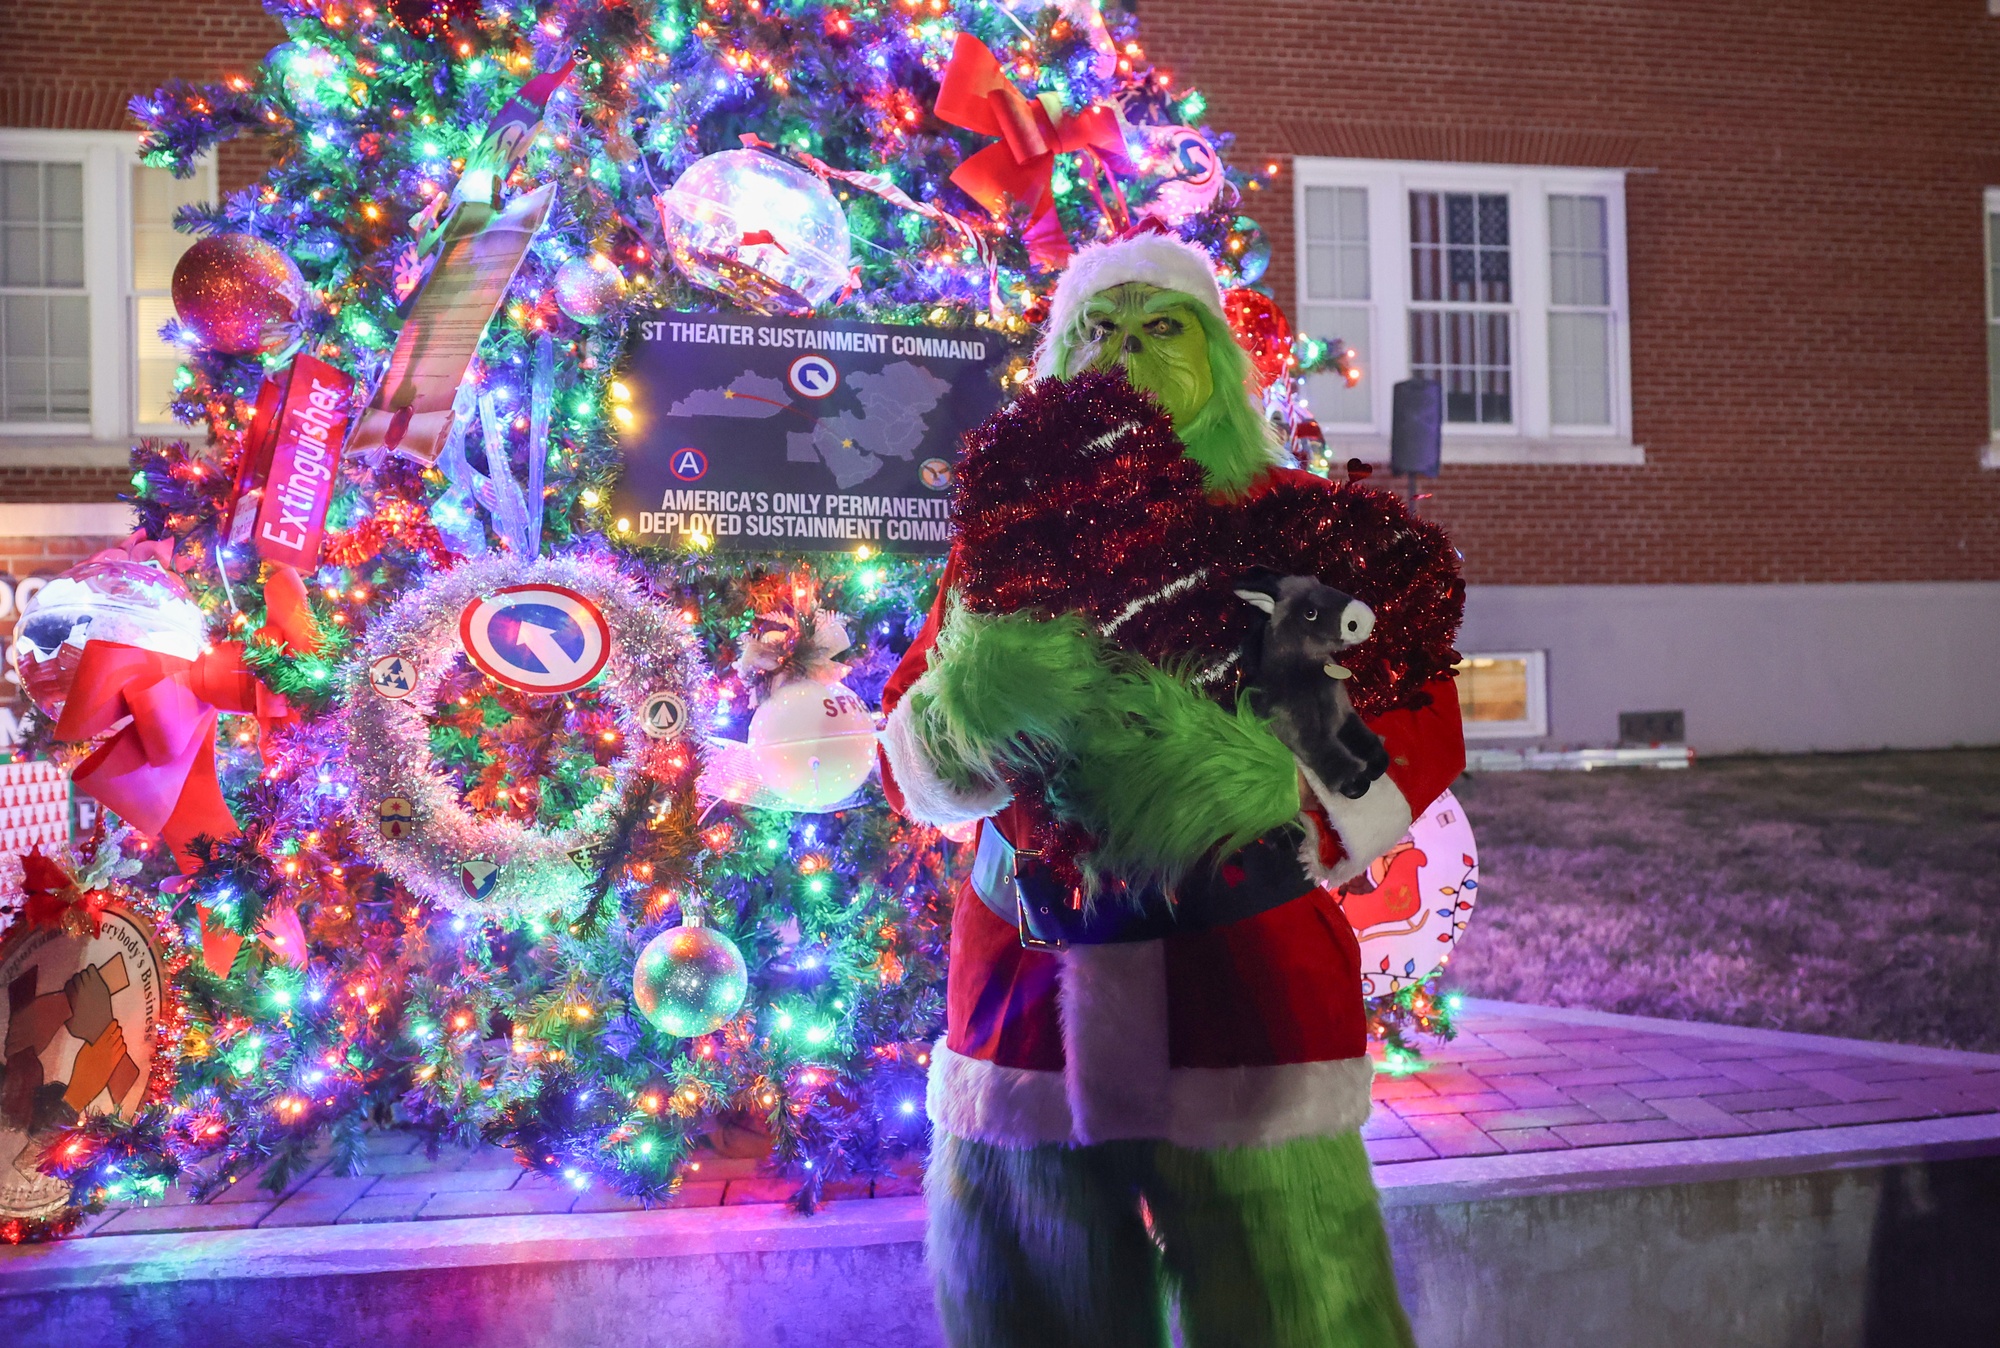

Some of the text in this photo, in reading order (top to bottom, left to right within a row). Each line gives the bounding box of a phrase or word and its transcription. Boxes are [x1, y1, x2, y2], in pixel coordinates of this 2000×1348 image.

[641, 320, 986, 361] ST THEATER SUSTAINMENT COMMAND
[262, 378, 337, 551] Extinguisher
[677, 451, 700, 474] A
[661, 489, 950, 519] AMERICA'S ONLY PERMANENTL
[639, 511, 742, 536] DEPLOYED
[745, 514, 883, 540] SUSTAINMENT
[101, 920, 146, 969] erybody's
[141, 967, 155, 1042] Business
